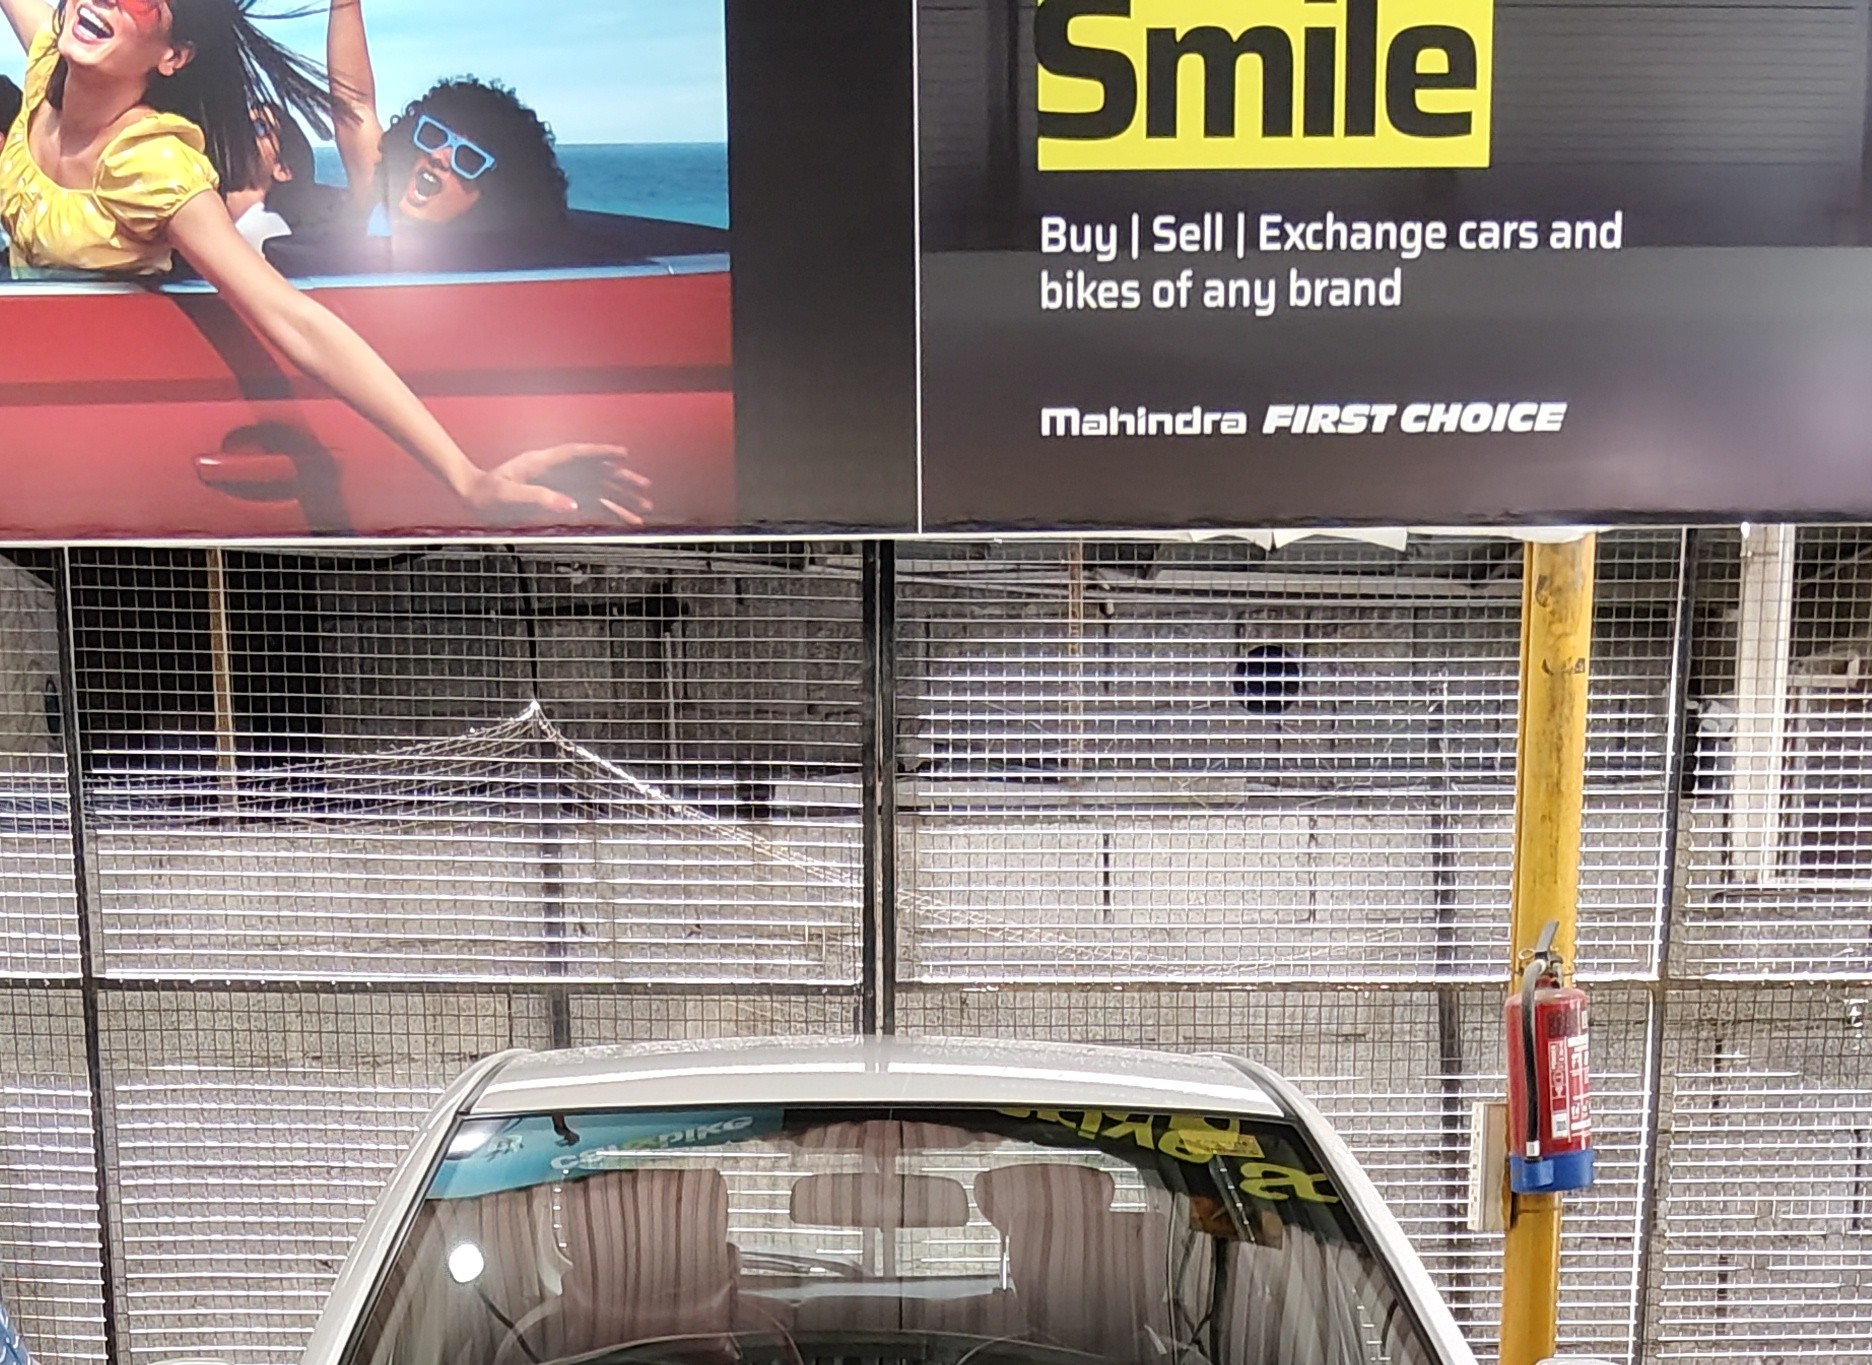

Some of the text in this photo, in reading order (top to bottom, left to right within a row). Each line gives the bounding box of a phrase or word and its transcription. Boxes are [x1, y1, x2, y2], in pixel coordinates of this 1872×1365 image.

[1034, 0, 1477, 140] Smile
[1041, 216, 1117, 262] Buy
[1152, 212, 1223, 252] Sell
[1259, 210, 1447, 259] Exchange
[1458, 220, 1539, 250] cars
[1549, 210, 1623, 250] and
[1040, 266, 1402, 317] bikes of any brand
[1041, 401, 1568, 437] Mahindra FIRST CHOICE
